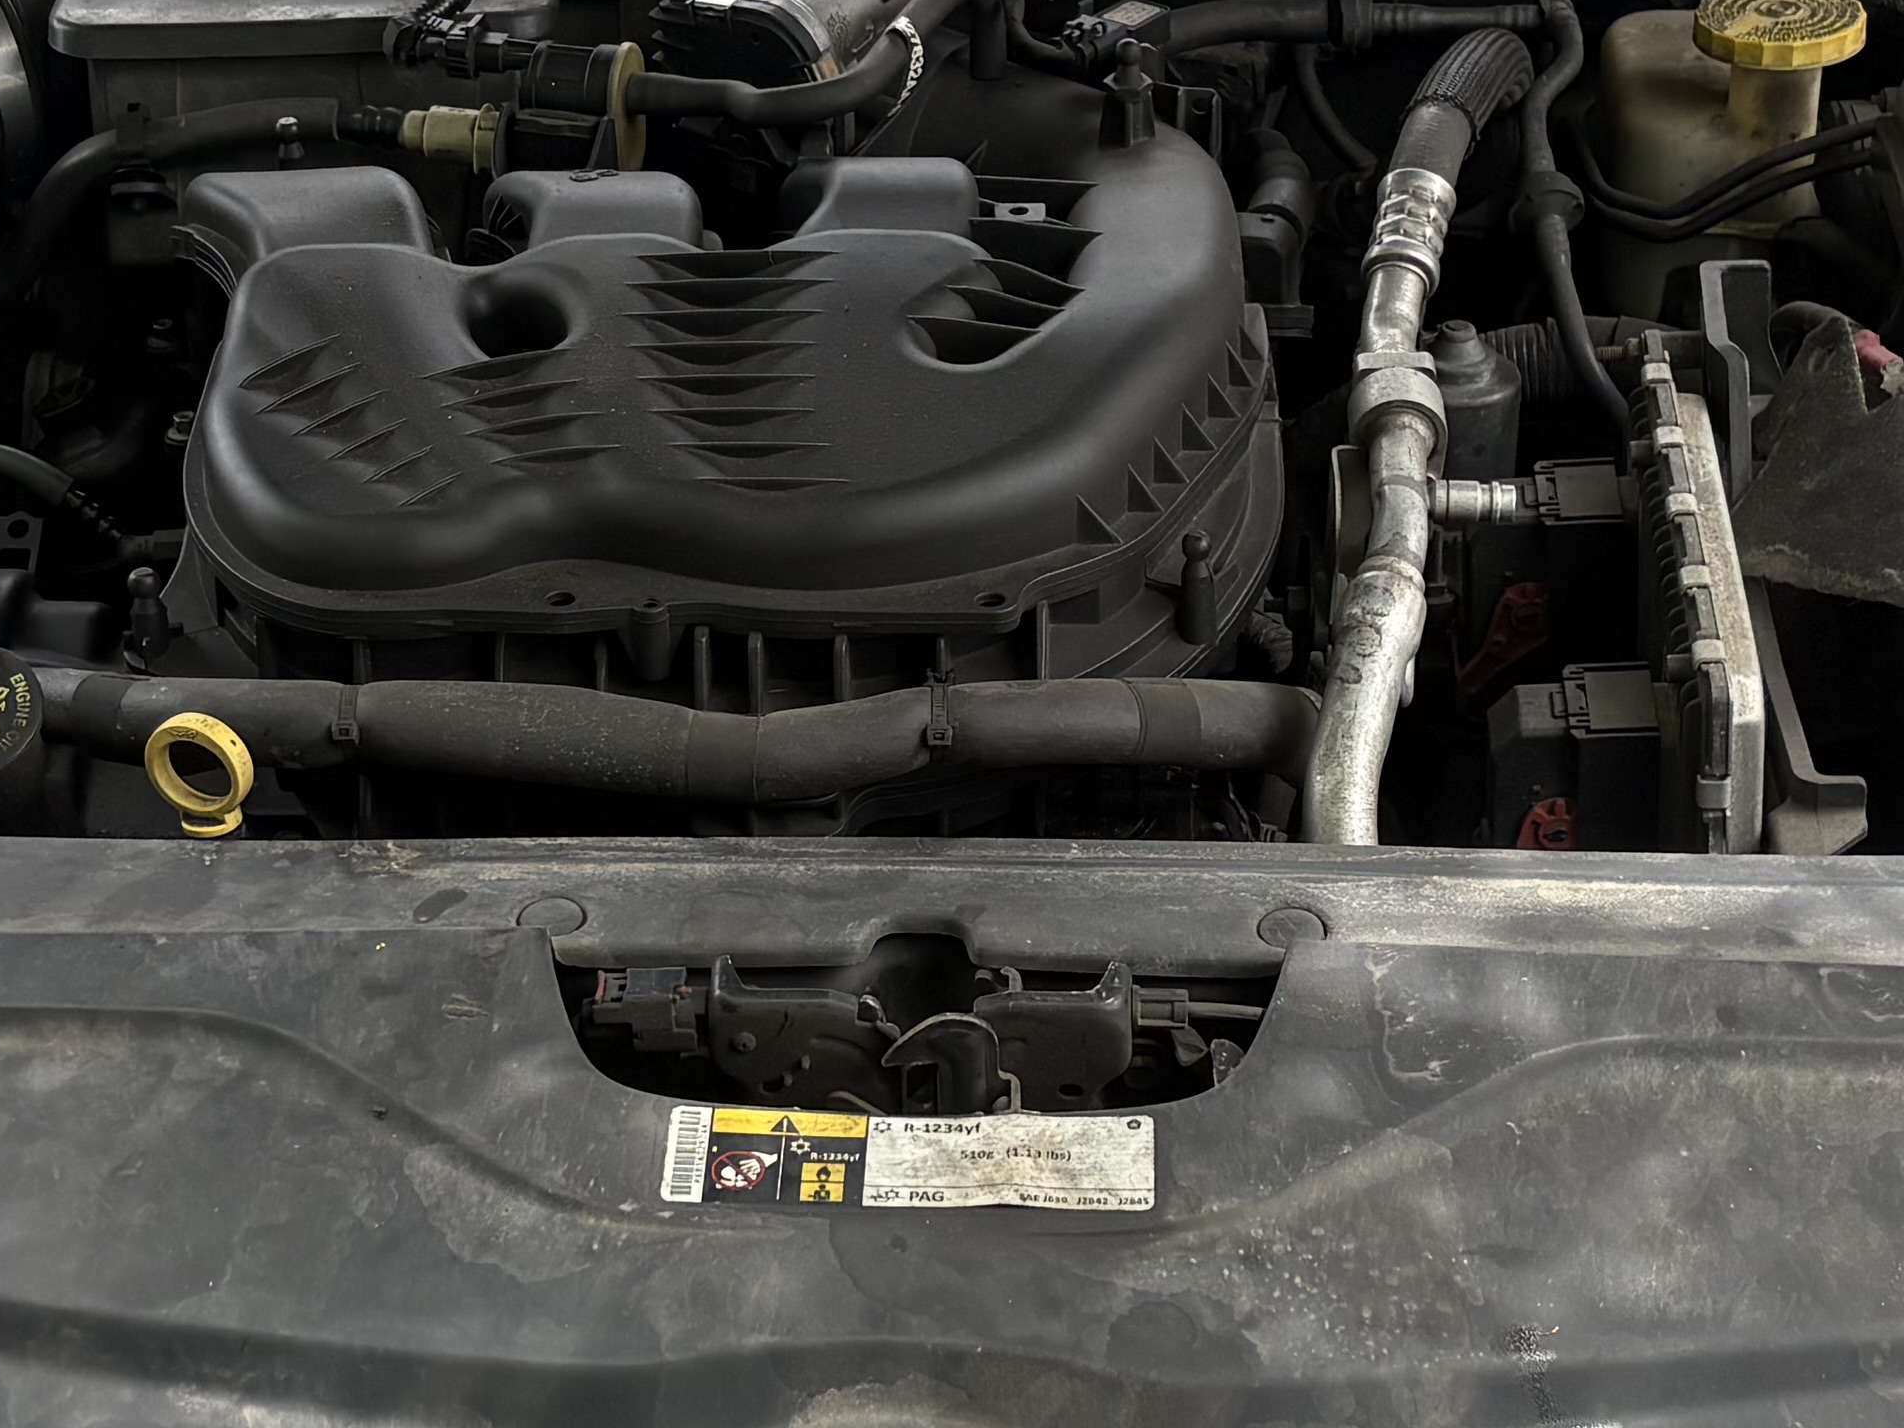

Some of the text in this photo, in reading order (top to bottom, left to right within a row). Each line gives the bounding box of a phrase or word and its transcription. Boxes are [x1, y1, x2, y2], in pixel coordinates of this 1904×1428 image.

[9, 672, 32, 728] ENGINE
[903, 1121, 982, 1136] R-1234yf
[908, 1190, 945, 1203] PAG
